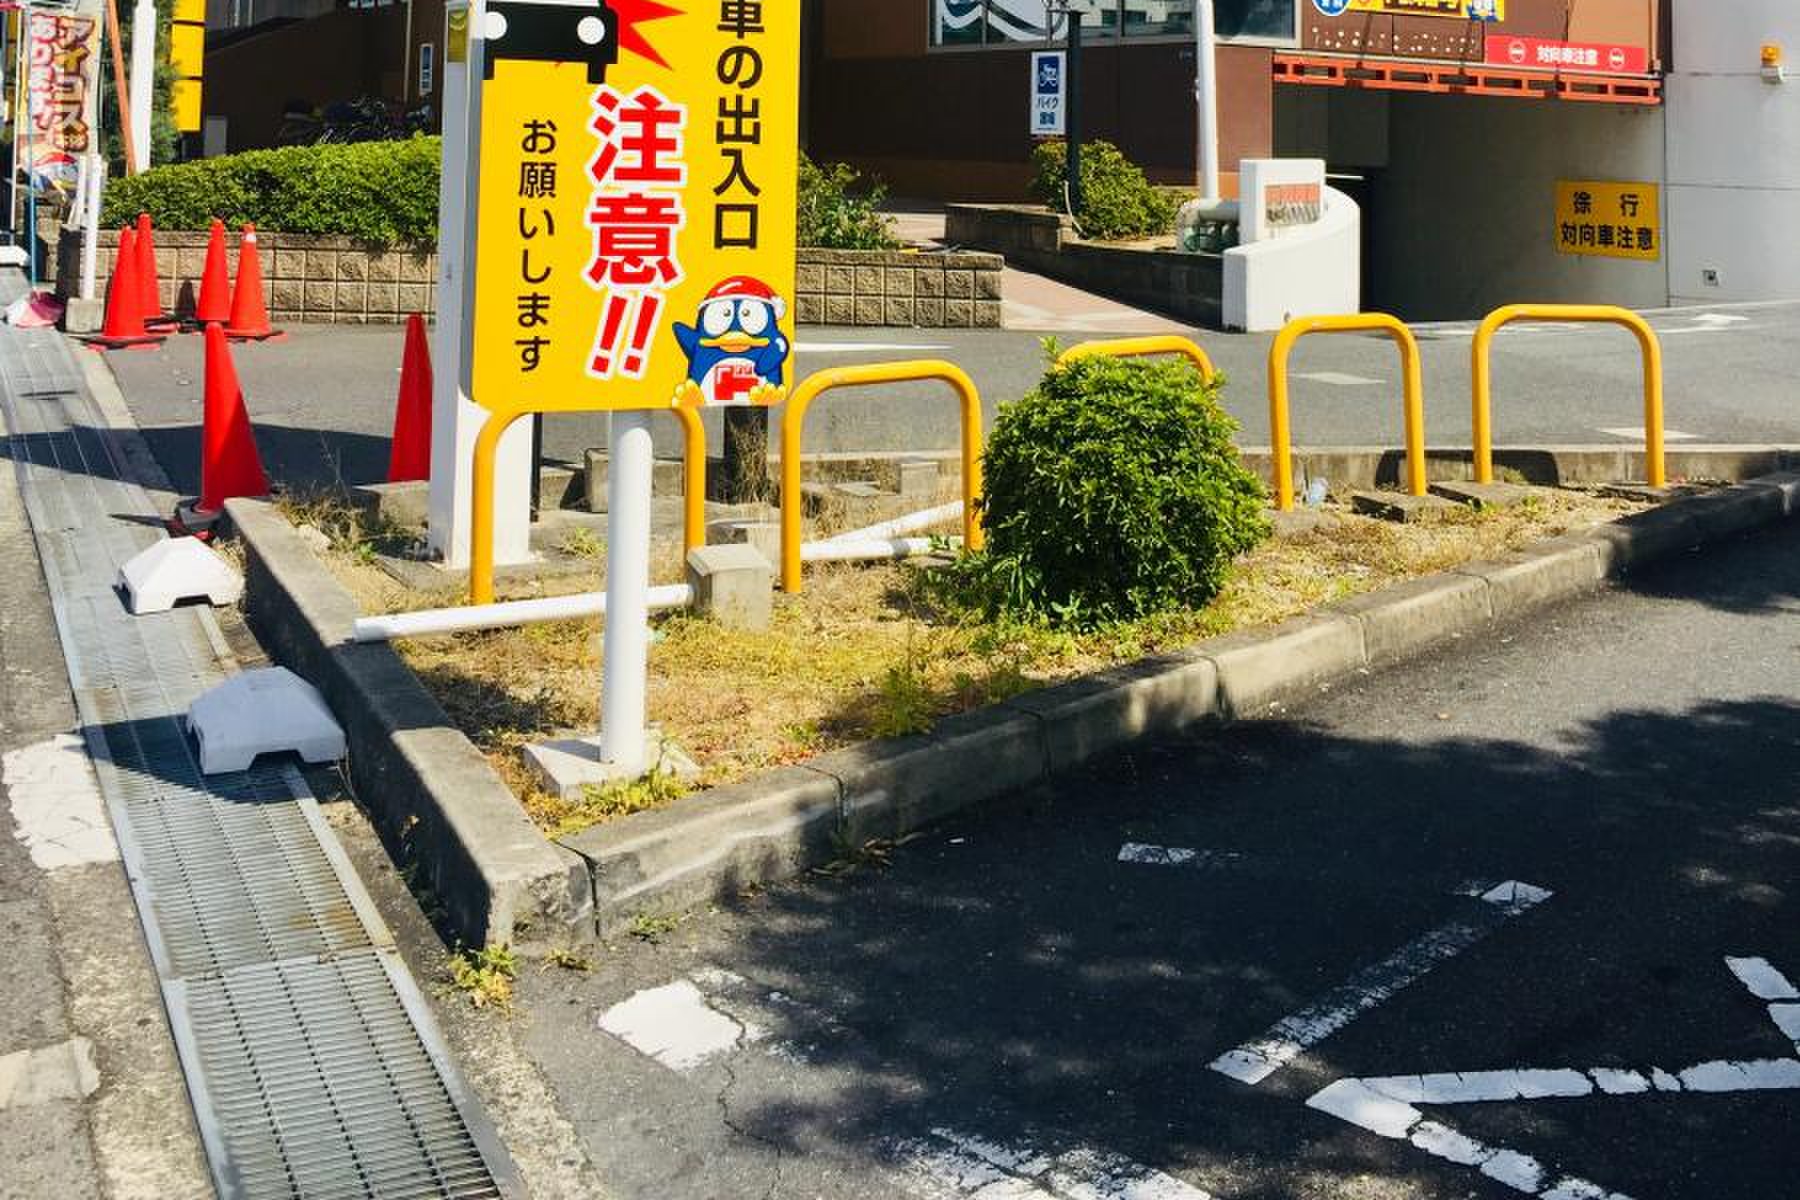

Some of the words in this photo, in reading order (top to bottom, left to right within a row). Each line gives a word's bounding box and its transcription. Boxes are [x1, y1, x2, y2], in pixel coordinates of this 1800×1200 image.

[514, 117, 558, 373] お願いします
[1560, 220, 1654, 251] 対向車注意
